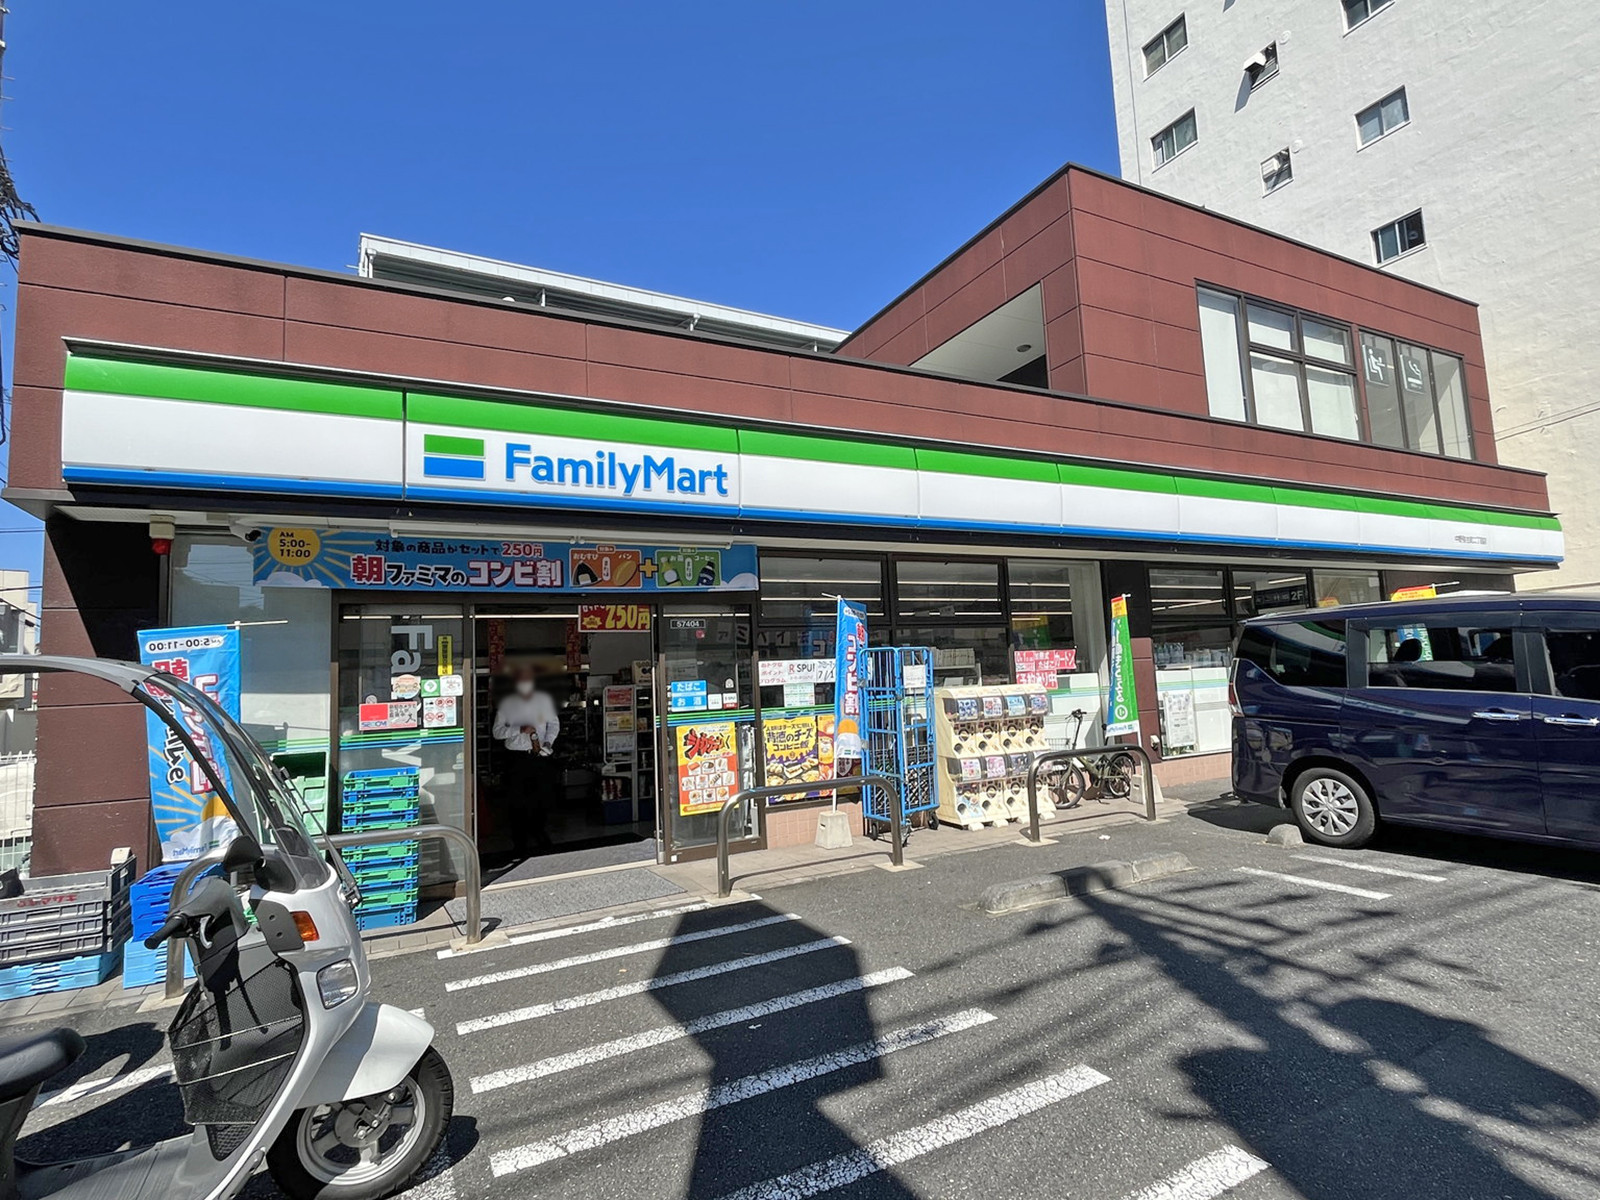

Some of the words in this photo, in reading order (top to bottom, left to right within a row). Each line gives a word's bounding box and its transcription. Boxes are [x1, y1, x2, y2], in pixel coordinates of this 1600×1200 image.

[505, 442, 729, 496] FamilyMart
[279, 538, 311, 548] 5:00-
[279, 549, 311, 558] 11:00
[676, 620, 700, 628] 57404
[677, 682, 701, 691] たばこ
